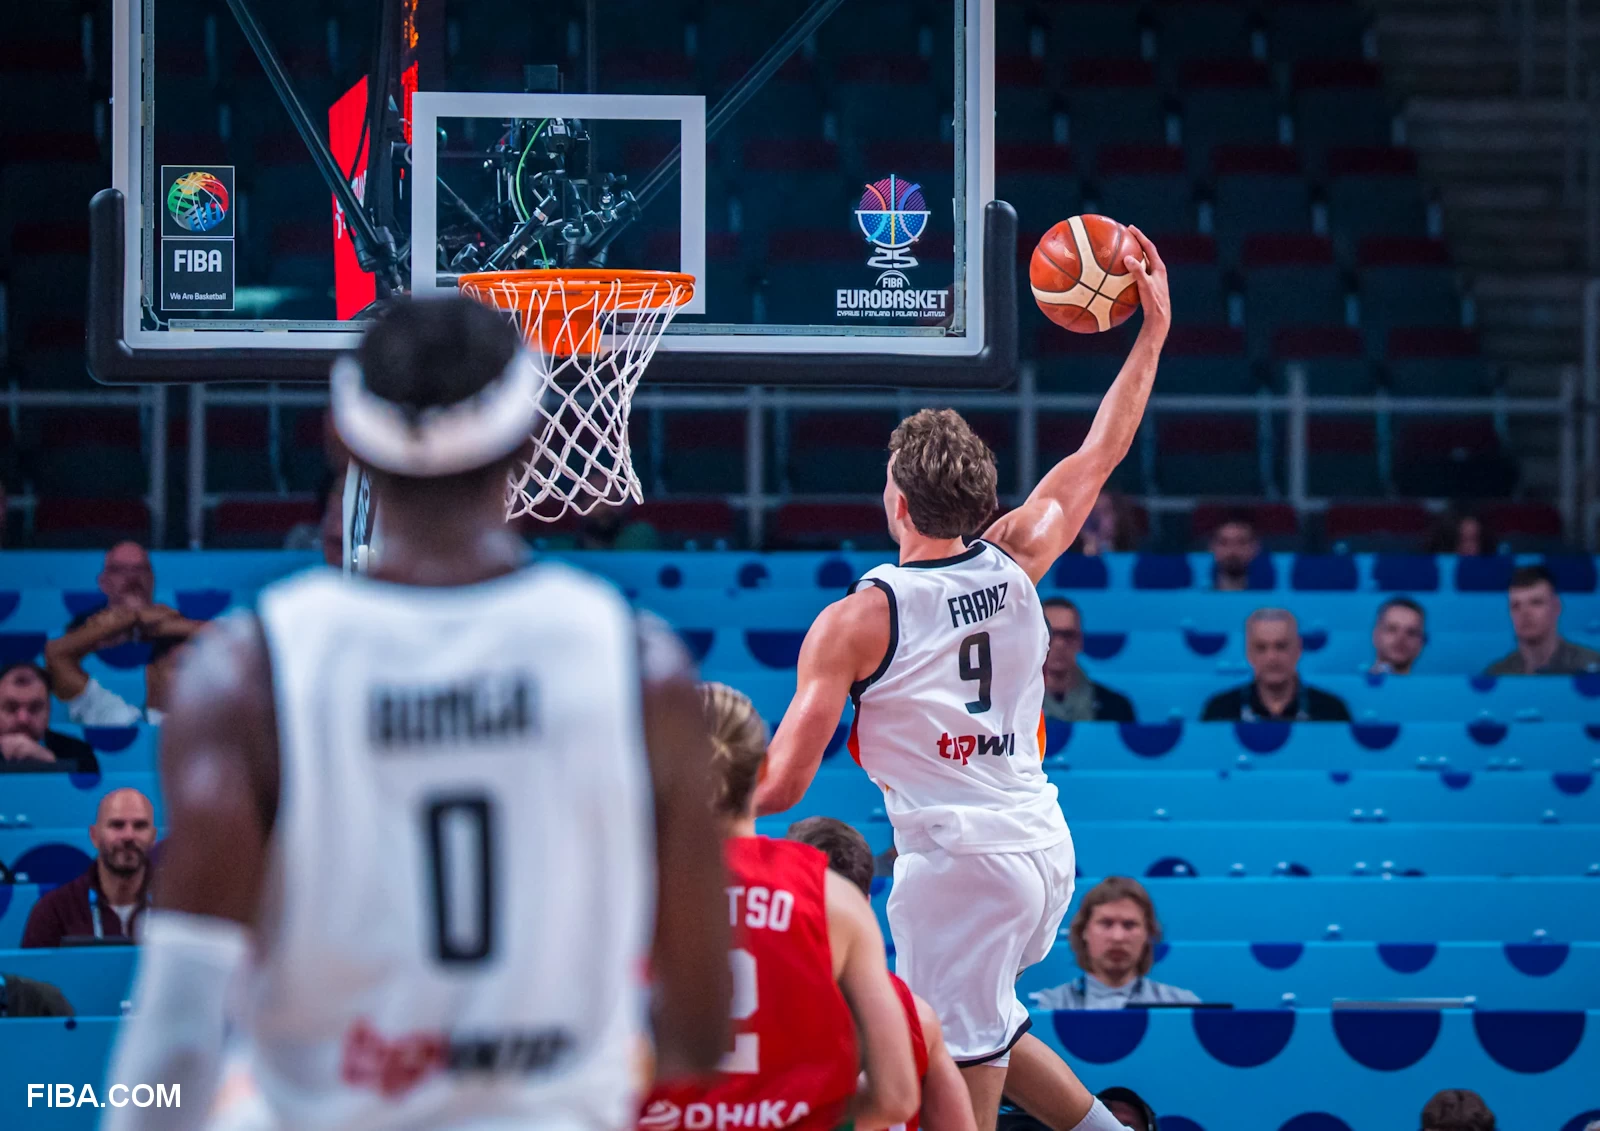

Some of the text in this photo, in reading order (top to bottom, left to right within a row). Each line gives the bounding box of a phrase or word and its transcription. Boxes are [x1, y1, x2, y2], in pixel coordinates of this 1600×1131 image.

[174, 249, 223, 273] FIBA
[882, 277, 904, 288] FIBA
[169, 292, 227, 301] We Are Basketball
[836, 289, 949, 309] EUROBASKET
[923, 310, 946, 318] LATVIA
[947, 582, 1009, 629] FRANZ
[958, 631, 993, 715] 9
[418, 789, 502, 970] 0
